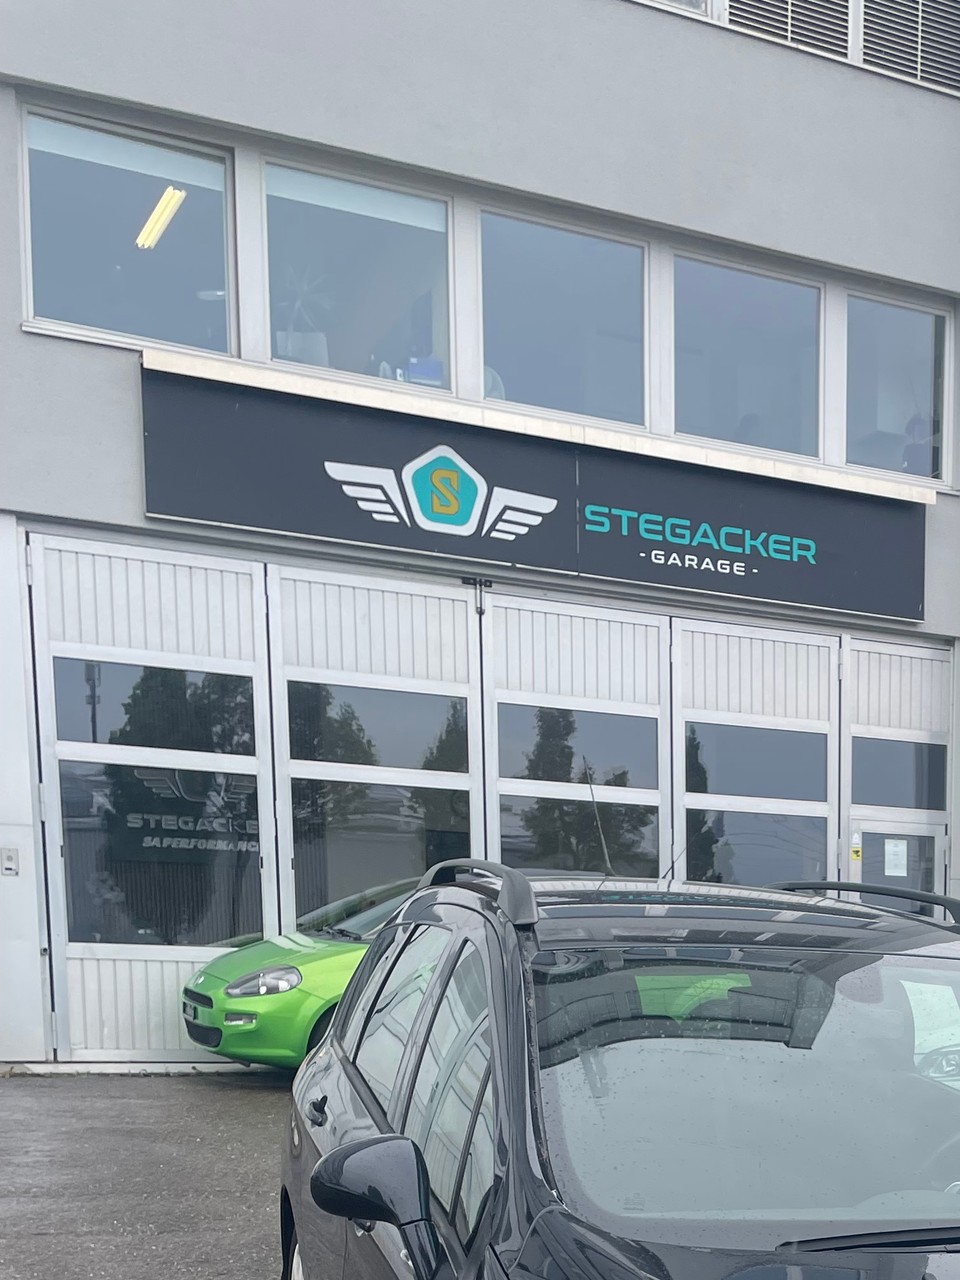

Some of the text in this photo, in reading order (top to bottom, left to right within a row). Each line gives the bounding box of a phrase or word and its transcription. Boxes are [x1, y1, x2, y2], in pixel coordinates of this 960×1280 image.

[431, 469, 460, 516] S
[584, 504, 817, 565] STEGACKER
[162, 836, 259, 852] PERFORMANC
